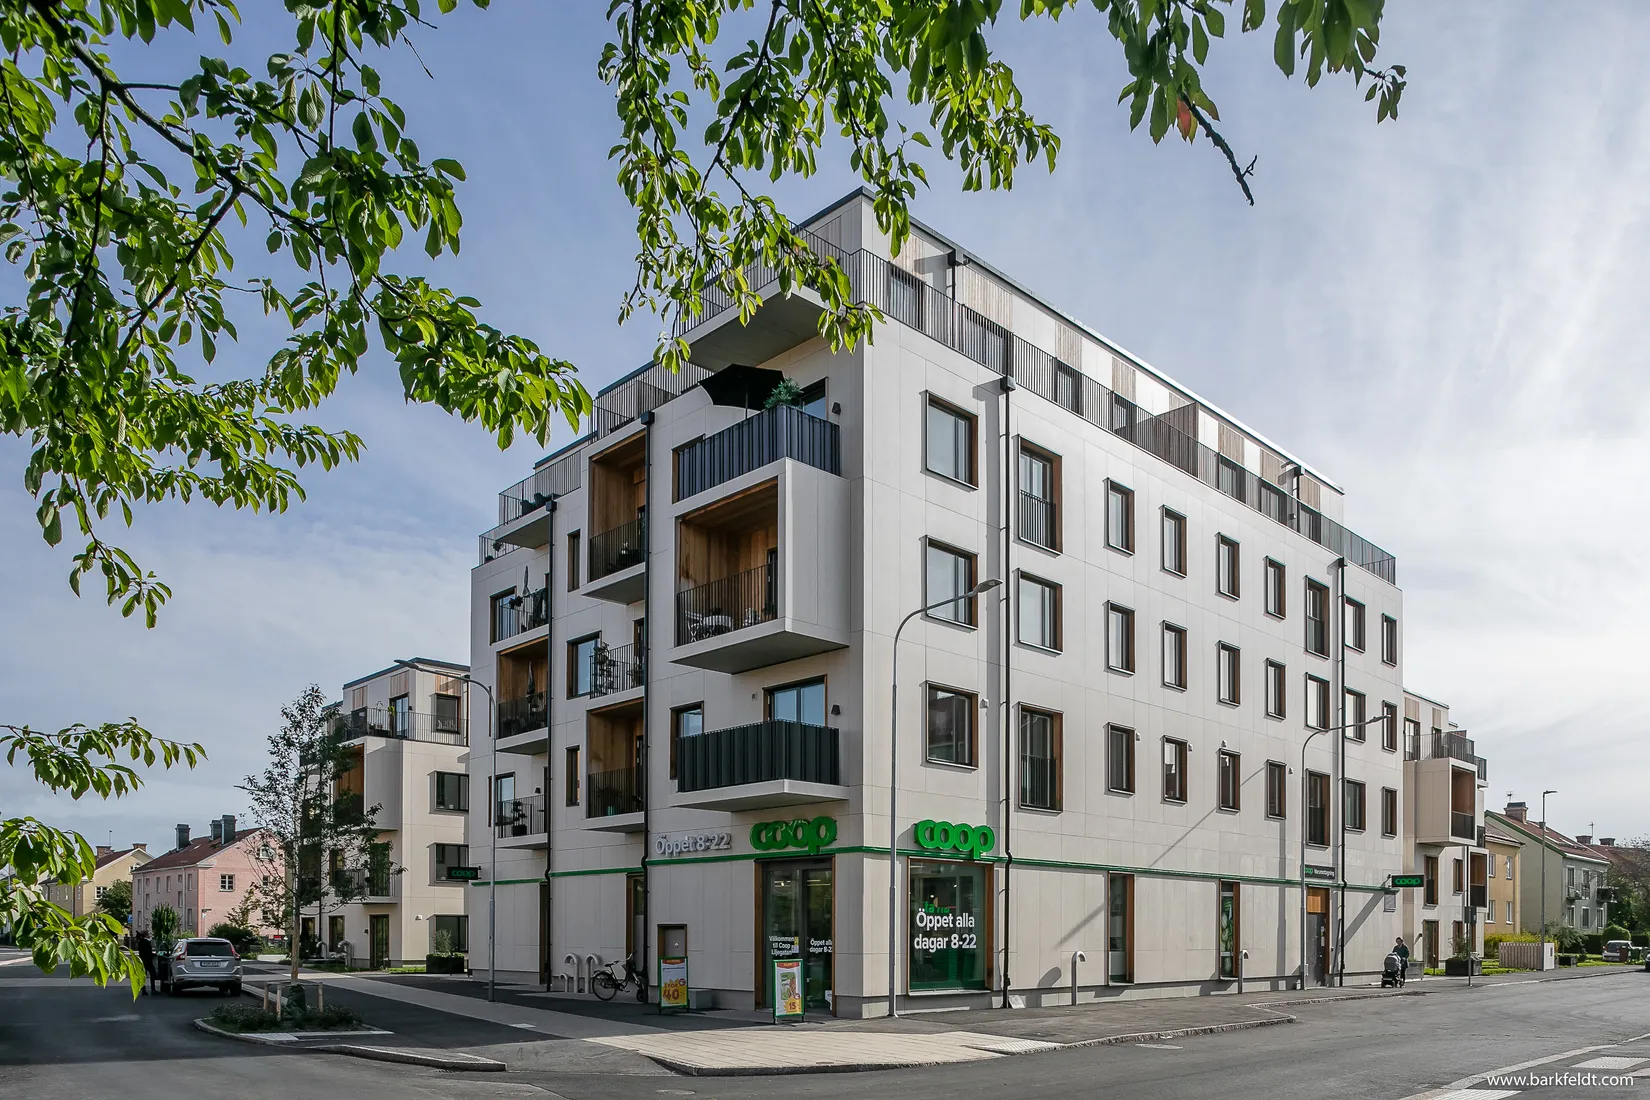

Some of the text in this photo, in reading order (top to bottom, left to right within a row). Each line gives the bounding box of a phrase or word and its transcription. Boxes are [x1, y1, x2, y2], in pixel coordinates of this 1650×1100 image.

[749, 816, 837, 853] coop
[914, 819, 995, 859] coop
[655, 832, 732, 857] Öppet 8-22
[451, 870, 476, 878] coop
[1304, 867, 1313, 875] oop
[1395, 878, 1421, 886] coop
[916, 908, 975, 931] Öppet alla
[778, 942, 791, 950] Coop
[810, 937, 825, 947] Öppet
[914, 934, 977, 953] dagar 8-22
[809, 946, 823, 954] dagar
